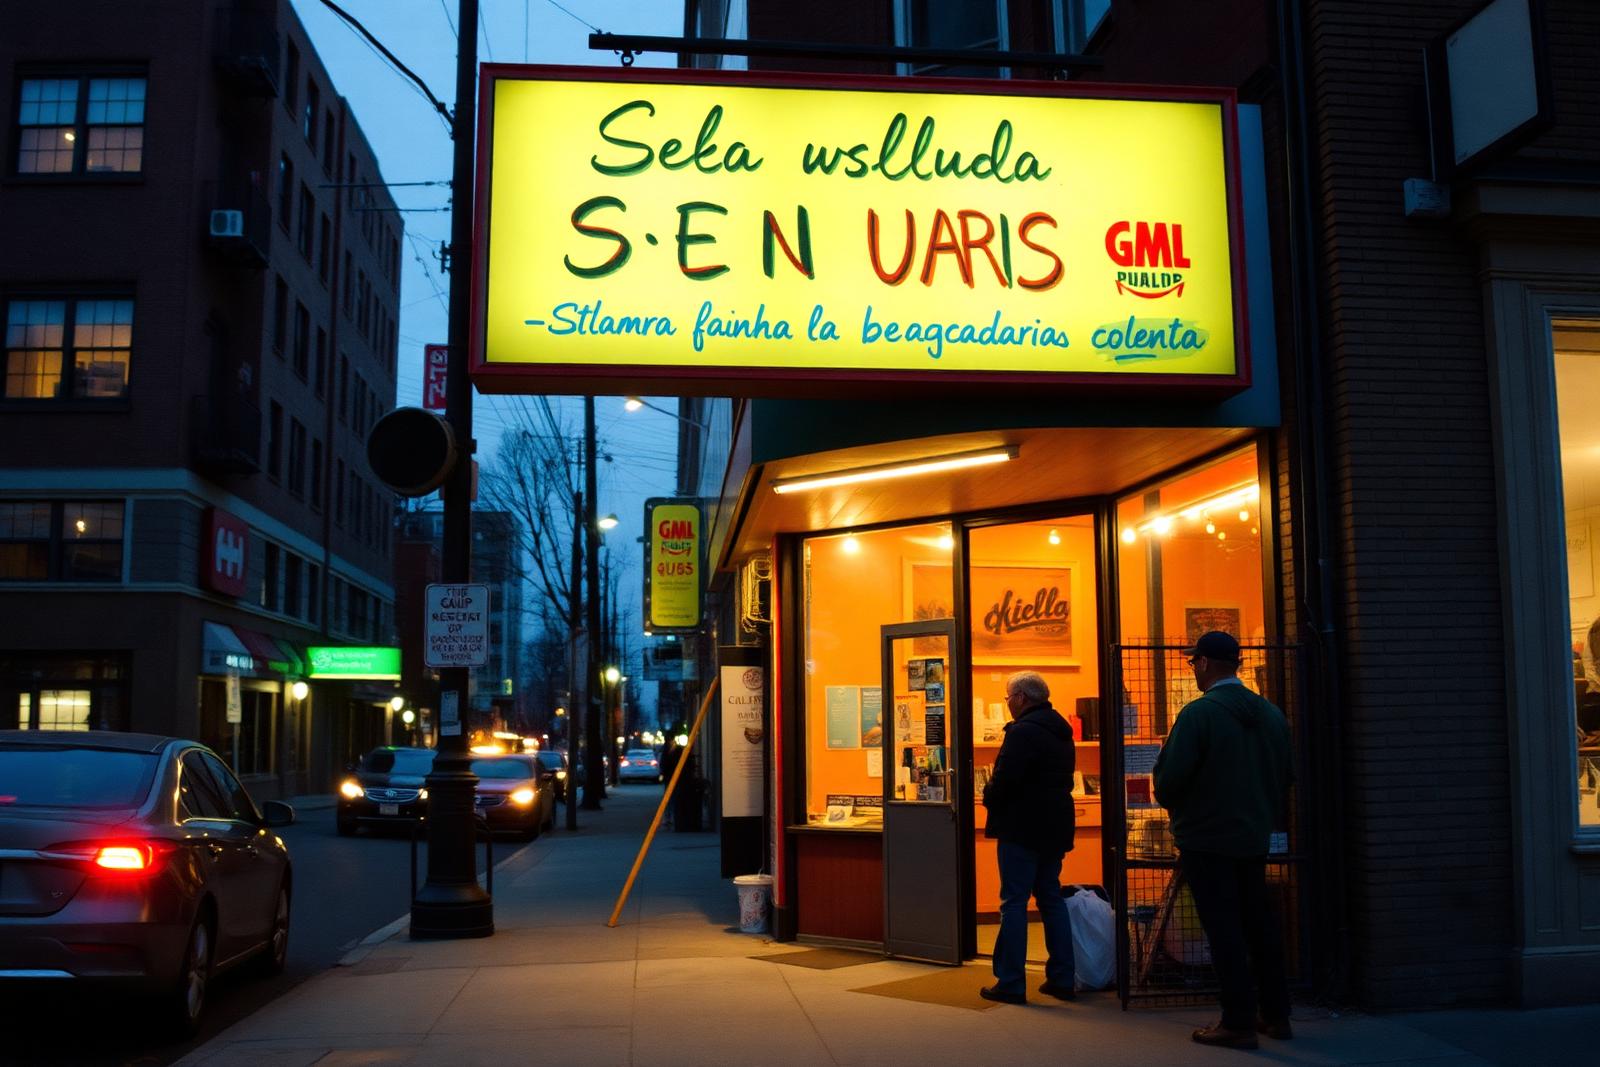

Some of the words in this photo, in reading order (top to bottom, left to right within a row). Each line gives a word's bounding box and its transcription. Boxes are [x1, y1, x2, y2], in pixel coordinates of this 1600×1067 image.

[591, 100, 764, 177] Seka
[867, 208, 1065, 291] UARIS
[1105, 220, 1191, 268] GML
[693, 301, 793, 352] fainha
[808, 304, 841, 341] la
[1091, 315, 1206, 350] colenta
